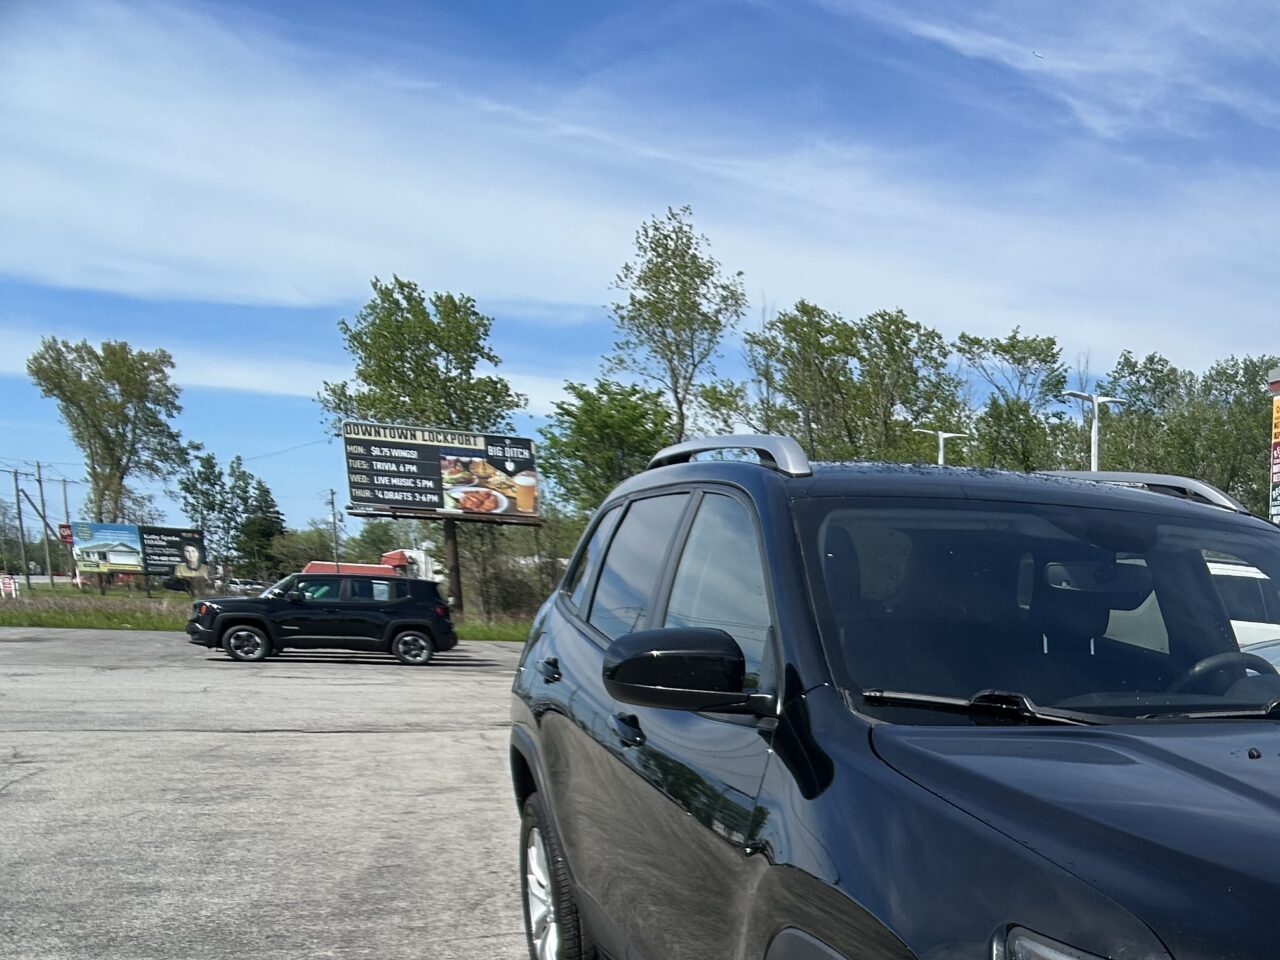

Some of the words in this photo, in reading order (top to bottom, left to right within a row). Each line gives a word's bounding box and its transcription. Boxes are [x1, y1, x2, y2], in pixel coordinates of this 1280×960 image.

[345, 423, 417, 440] DOWNTOWN
[421, 431, 478, 446] LOCKPORT
[346, 444, 366, 454] MON:
[390, 448, 418, 458] WINGS!
[487, 445, 503, 456] BIG
[504, 447, 530, 458] DITCH
[348, 459, 369, 469] TUES:
[372, 461, 397, 471] TRIVIA
[405, 464, 417, 472] PM
[349, 474, 370, 483] WED:
[374, 476, 391, 485] LIVE
[391, 477, 415, 487] MUSIC
[422, 480, 434, 488] PM
[384, 491, 412, 500] DRAFTS
